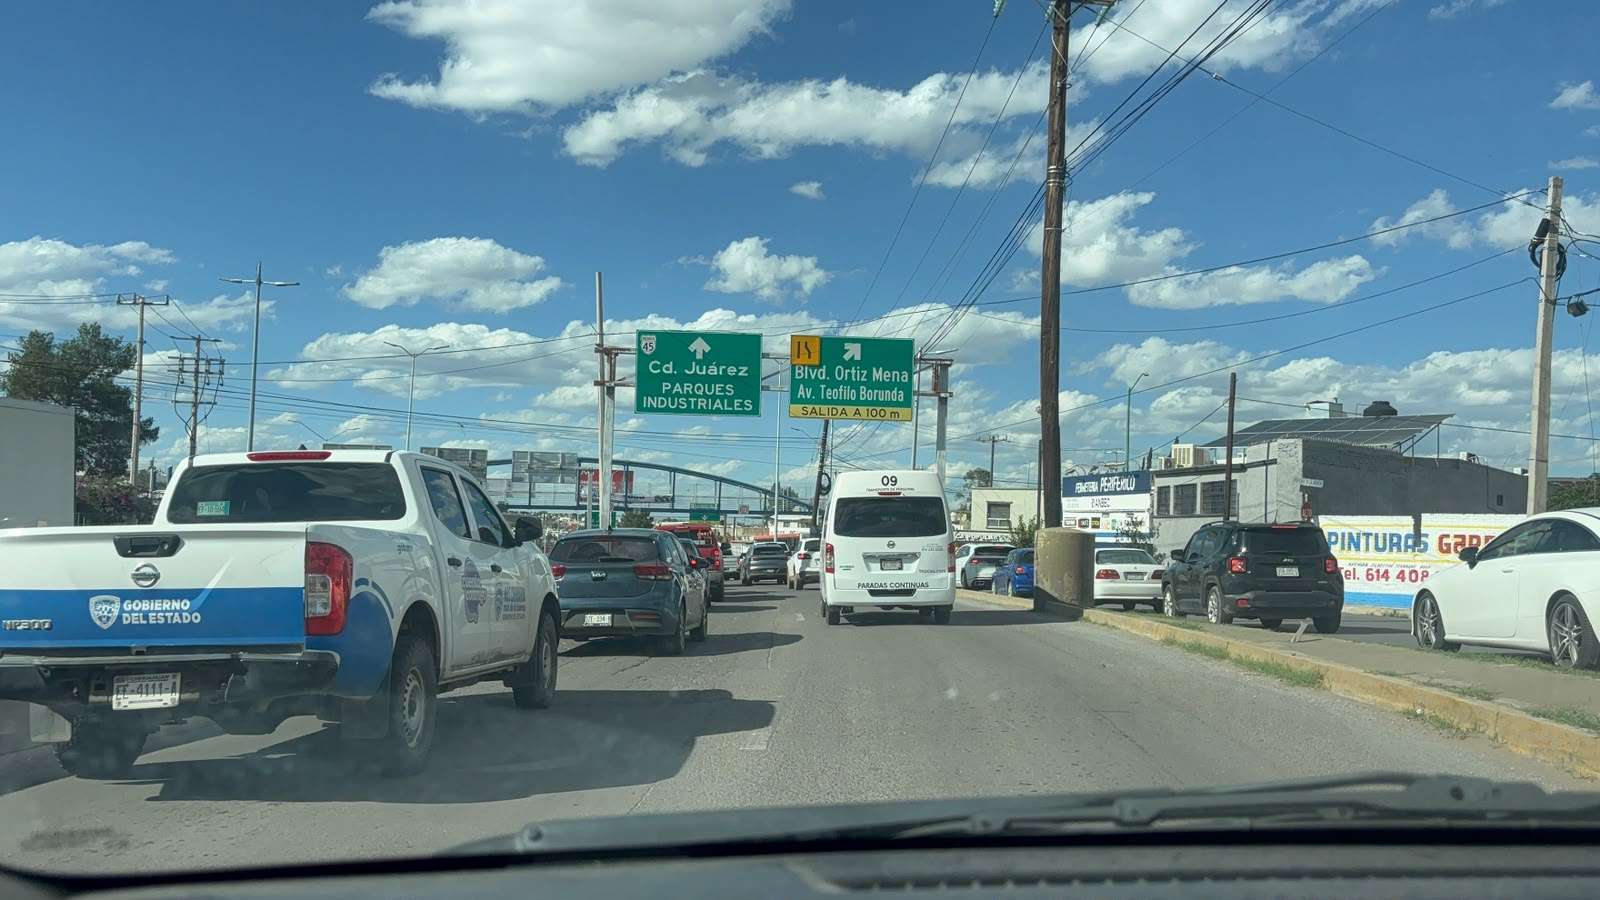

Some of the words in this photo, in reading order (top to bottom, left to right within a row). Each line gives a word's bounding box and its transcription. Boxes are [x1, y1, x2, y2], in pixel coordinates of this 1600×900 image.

[643, 342, 654, 351] 45
[648, 360, 677, 374] Cd.
[684, 361, 749, 377] Juárez
[794, 365, 830, 381] Blvd.
[835, 366, 869, 381] Ortiz
[872, 367, 909, 382] Mena
[662, 382, 734, 396] PARQUES
[797, 386, 815, 400] Av.
[859, 387, 904, 402] Borunda
[643, 397, 753, 411] INDUSTRIALES
[801, 406, 848, 418] SALIDA
[852, 408, 862, 417] A
[865, 408, 887, 418] 100
[881, 475, 898, 486] 09
[1327, 531, 1430, 553] PINTURAS
[1365, 568, 1390, 582] 614
[123, 599, 191, 611] GOBIERNO
[122, 613, 148, 625] DEL
[149, 612, 202, 624] ESTADO
